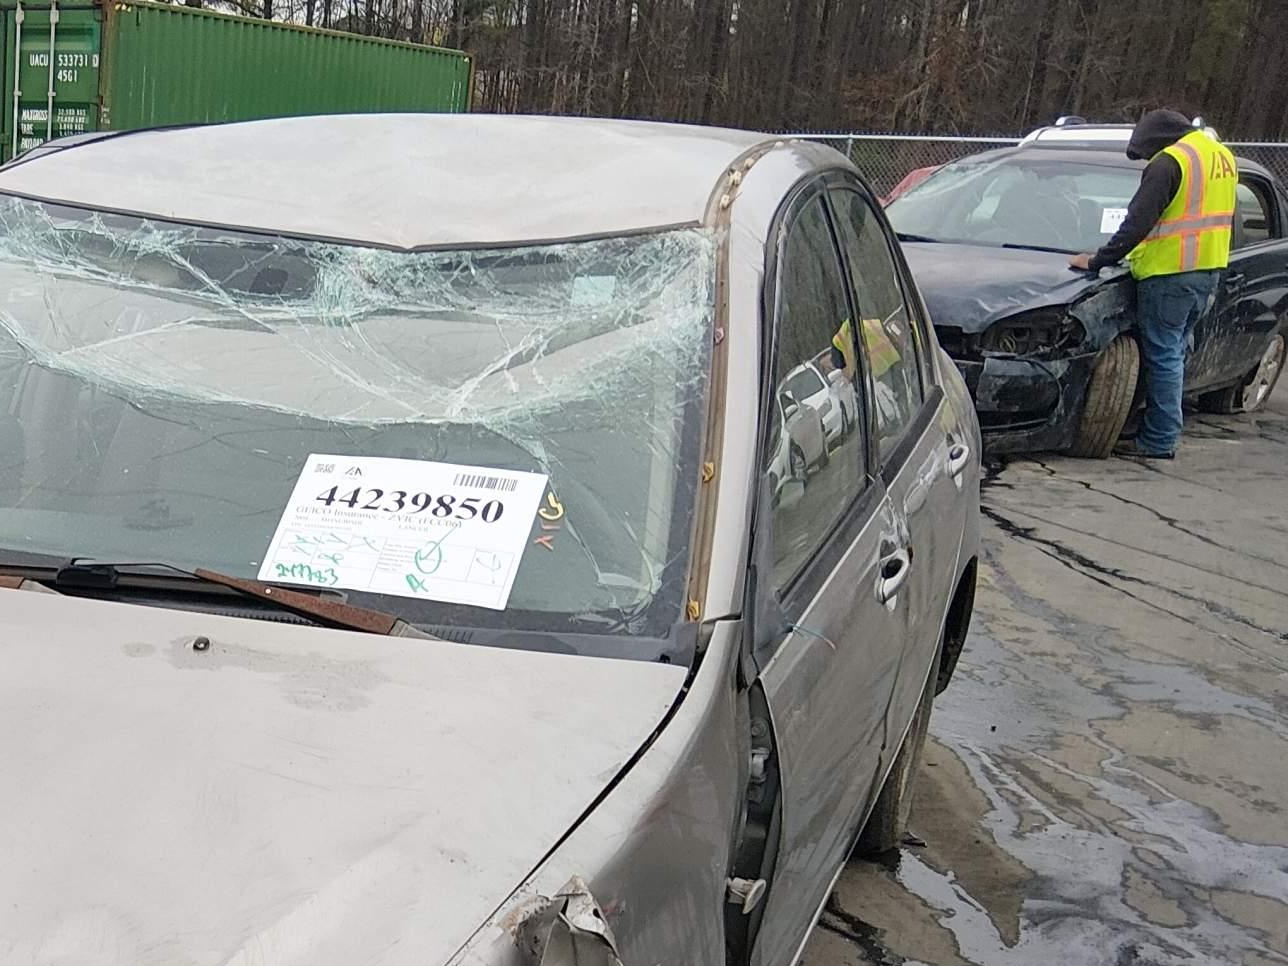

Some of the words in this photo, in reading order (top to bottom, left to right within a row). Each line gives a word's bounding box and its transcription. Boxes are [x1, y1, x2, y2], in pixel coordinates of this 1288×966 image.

[29, 53, 48, 67] UACU
[58, 53, 88, 67] 533731
[57, 69, 78, 82] 45G1
[315, 485, 505, 524] 44239850
